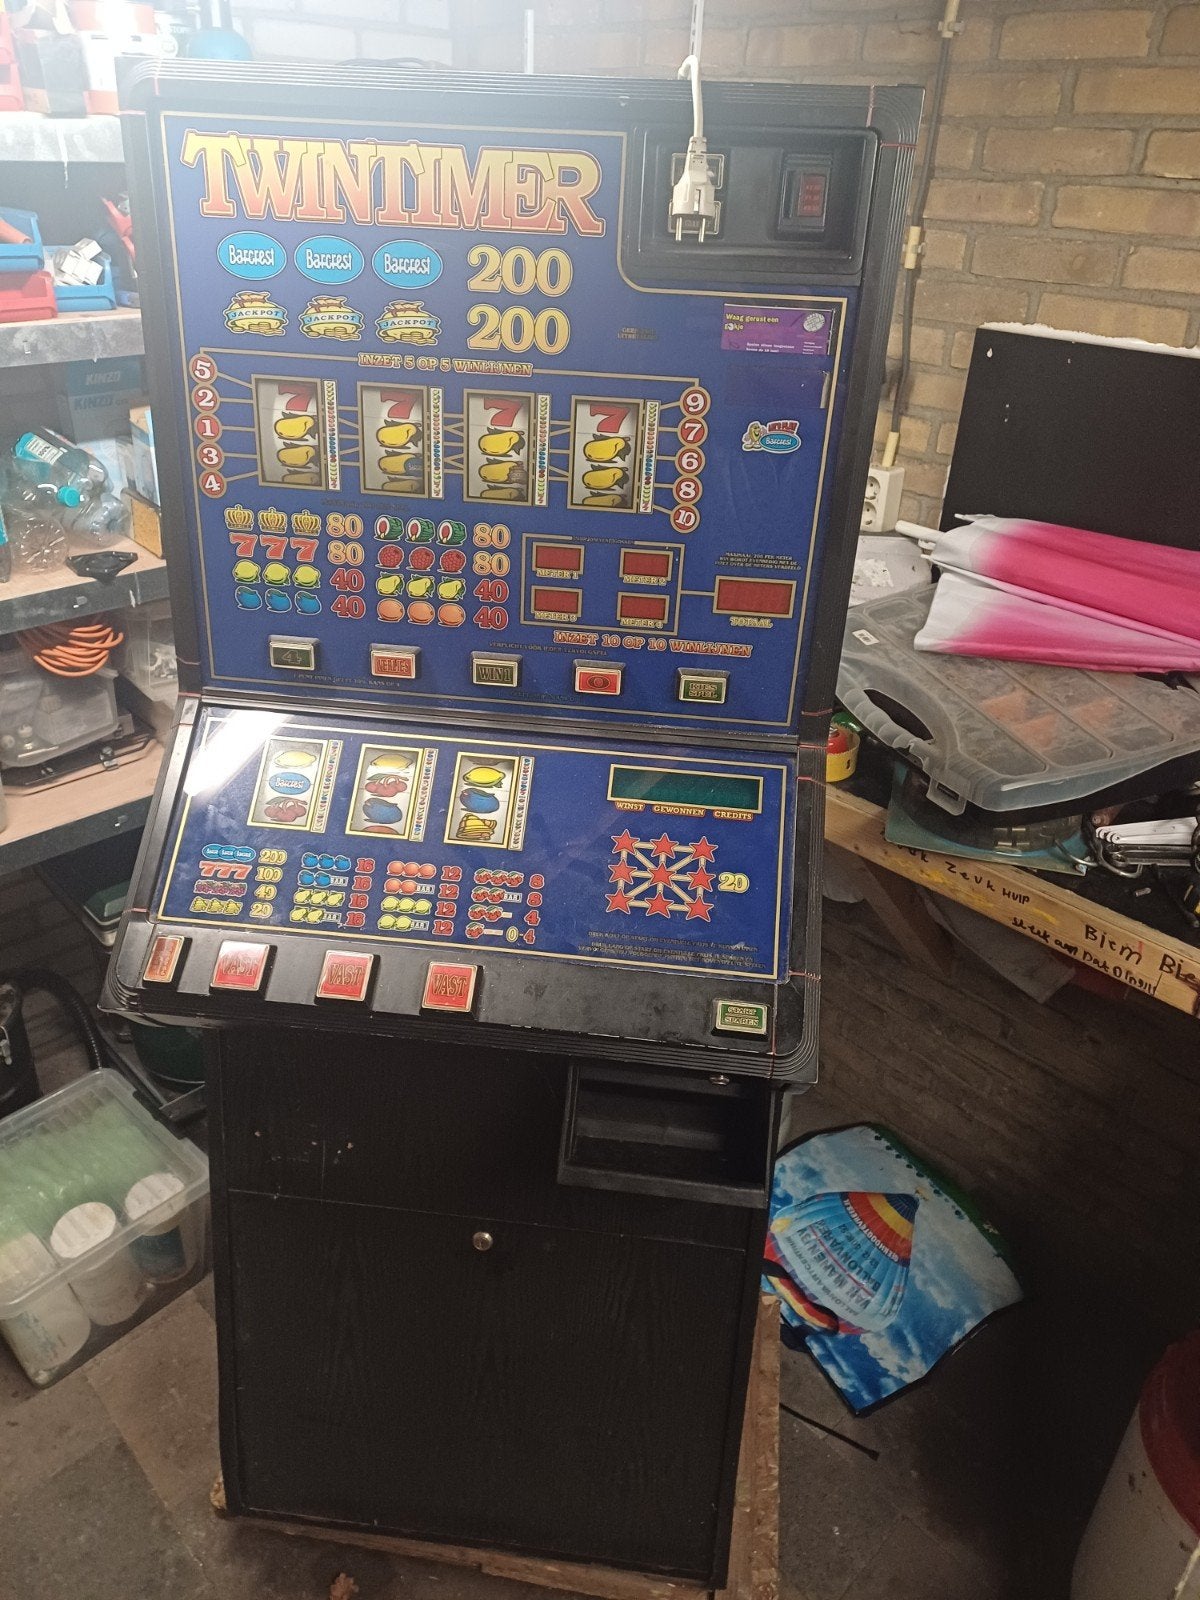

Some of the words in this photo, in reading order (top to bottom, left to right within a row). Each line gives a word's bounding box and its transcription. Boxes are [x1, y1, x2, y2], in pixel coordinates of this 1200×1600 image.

[180, 129, 606, 237] TWINTIMER
[228, 242, 275, 267] Barcrest
[305, 246, 352, 272] Barcrest
[383, 250, 431, 275] Barcrest
[467, 244, 573, 296] 200
[725, 312, 744, 323] Waag
[230, 308, 282, 319] JACKPOT
[306, 313, 356, 324] JACKPOT
[383, 317, 433, 329] JACKPOT
[466, 303, 571, 355] 200
[194, 360, 211, 379] 5
[358, 353, 402, 369] INZET
[404, 356, 415, 370] 5
[418, 357, 439, 371] OP
[441, 358, 451, 372] 5
[454, 360, 532, 376] WINLIJNEN
[85, 370, 121, 385] KINZO
[198, 389, 214, 407] 2
[278, 384, 312, 411] 7
[381, 391, 419, 419] 7
[687, 393, 704, 412] 9
[484, 399, 523, 427] 7
[590, 404, 631, 433] 7
[201, 420, 214, 436] 1
[684, 423, 702, 440] 7
[203, 448, 218, 465] 3
[682, 452, 698, 469] 6
[205, 475, 220, 491] 4
[680, 481, 696, 498] 8
[325, 511, 364, 539] 80
[675, 509, 696, 527] 10
[473, 522, 511, 549] 80
[327, 540, 365, 567] 80
[473, 550, 511, 577] 80
[329, 567, 365, 593] 40
[536, 568, 571, 579] METER
[623, 574, 657, 584] METER
[658, 576, 666, 586] 2
[473, 578, 509, 603] 40
[330, 595, 366, 620] 40
[473, 605, 509, 630] 40
[534, 610, 568, 621] METER
[569, 612, 577, 623] 3
[620, 617, 654, 628] METER
[730, 616, 773, 629] TOTAAL
[554, 630, 599, 646] INZET
[602, 633, 620, 647] 10
[622, 635, 645, 650] OP
[647, 637, 667, 651] 10
[669, 639, 753, 658] WINLIJNEN
[281, 648, 303, 664] 4
[615, 802, 645, 812] WINST
[652, 803, 705, 817] GEWONNEN
[714, 810, 753, 821] CREDITS
[258, 848, 287, 865] 200
[199, 860, 252, 879] 777
[255, 866, 283, 882] 100
[355, 858, 375, 874] 16
[441, 866, 463, 882] 12
[352, 875, 373, 891] 16
[529, 873, 545, 890] 8
[718, 872, 749, 894] 20
[254, 884, 277, 900] 40
[438, 883, 460, 900] 12
[526, 891, 543, 908] 8
[348, 893, 369, 909] 16
[434, 901, 457, 918] 12
[249, 902, 273, 919] 20
[523, 909, 541, 927] 4
[432, 919, 454, 936] 12
[327, 966, 363, 985] VAST
[433, 975, 468, 997] VAST
[726, 1005, 757, 1016] START
[724, 1016, 759, 1027] SPAREN
[814, 1219, 882, 1291] BALLONVAREN
